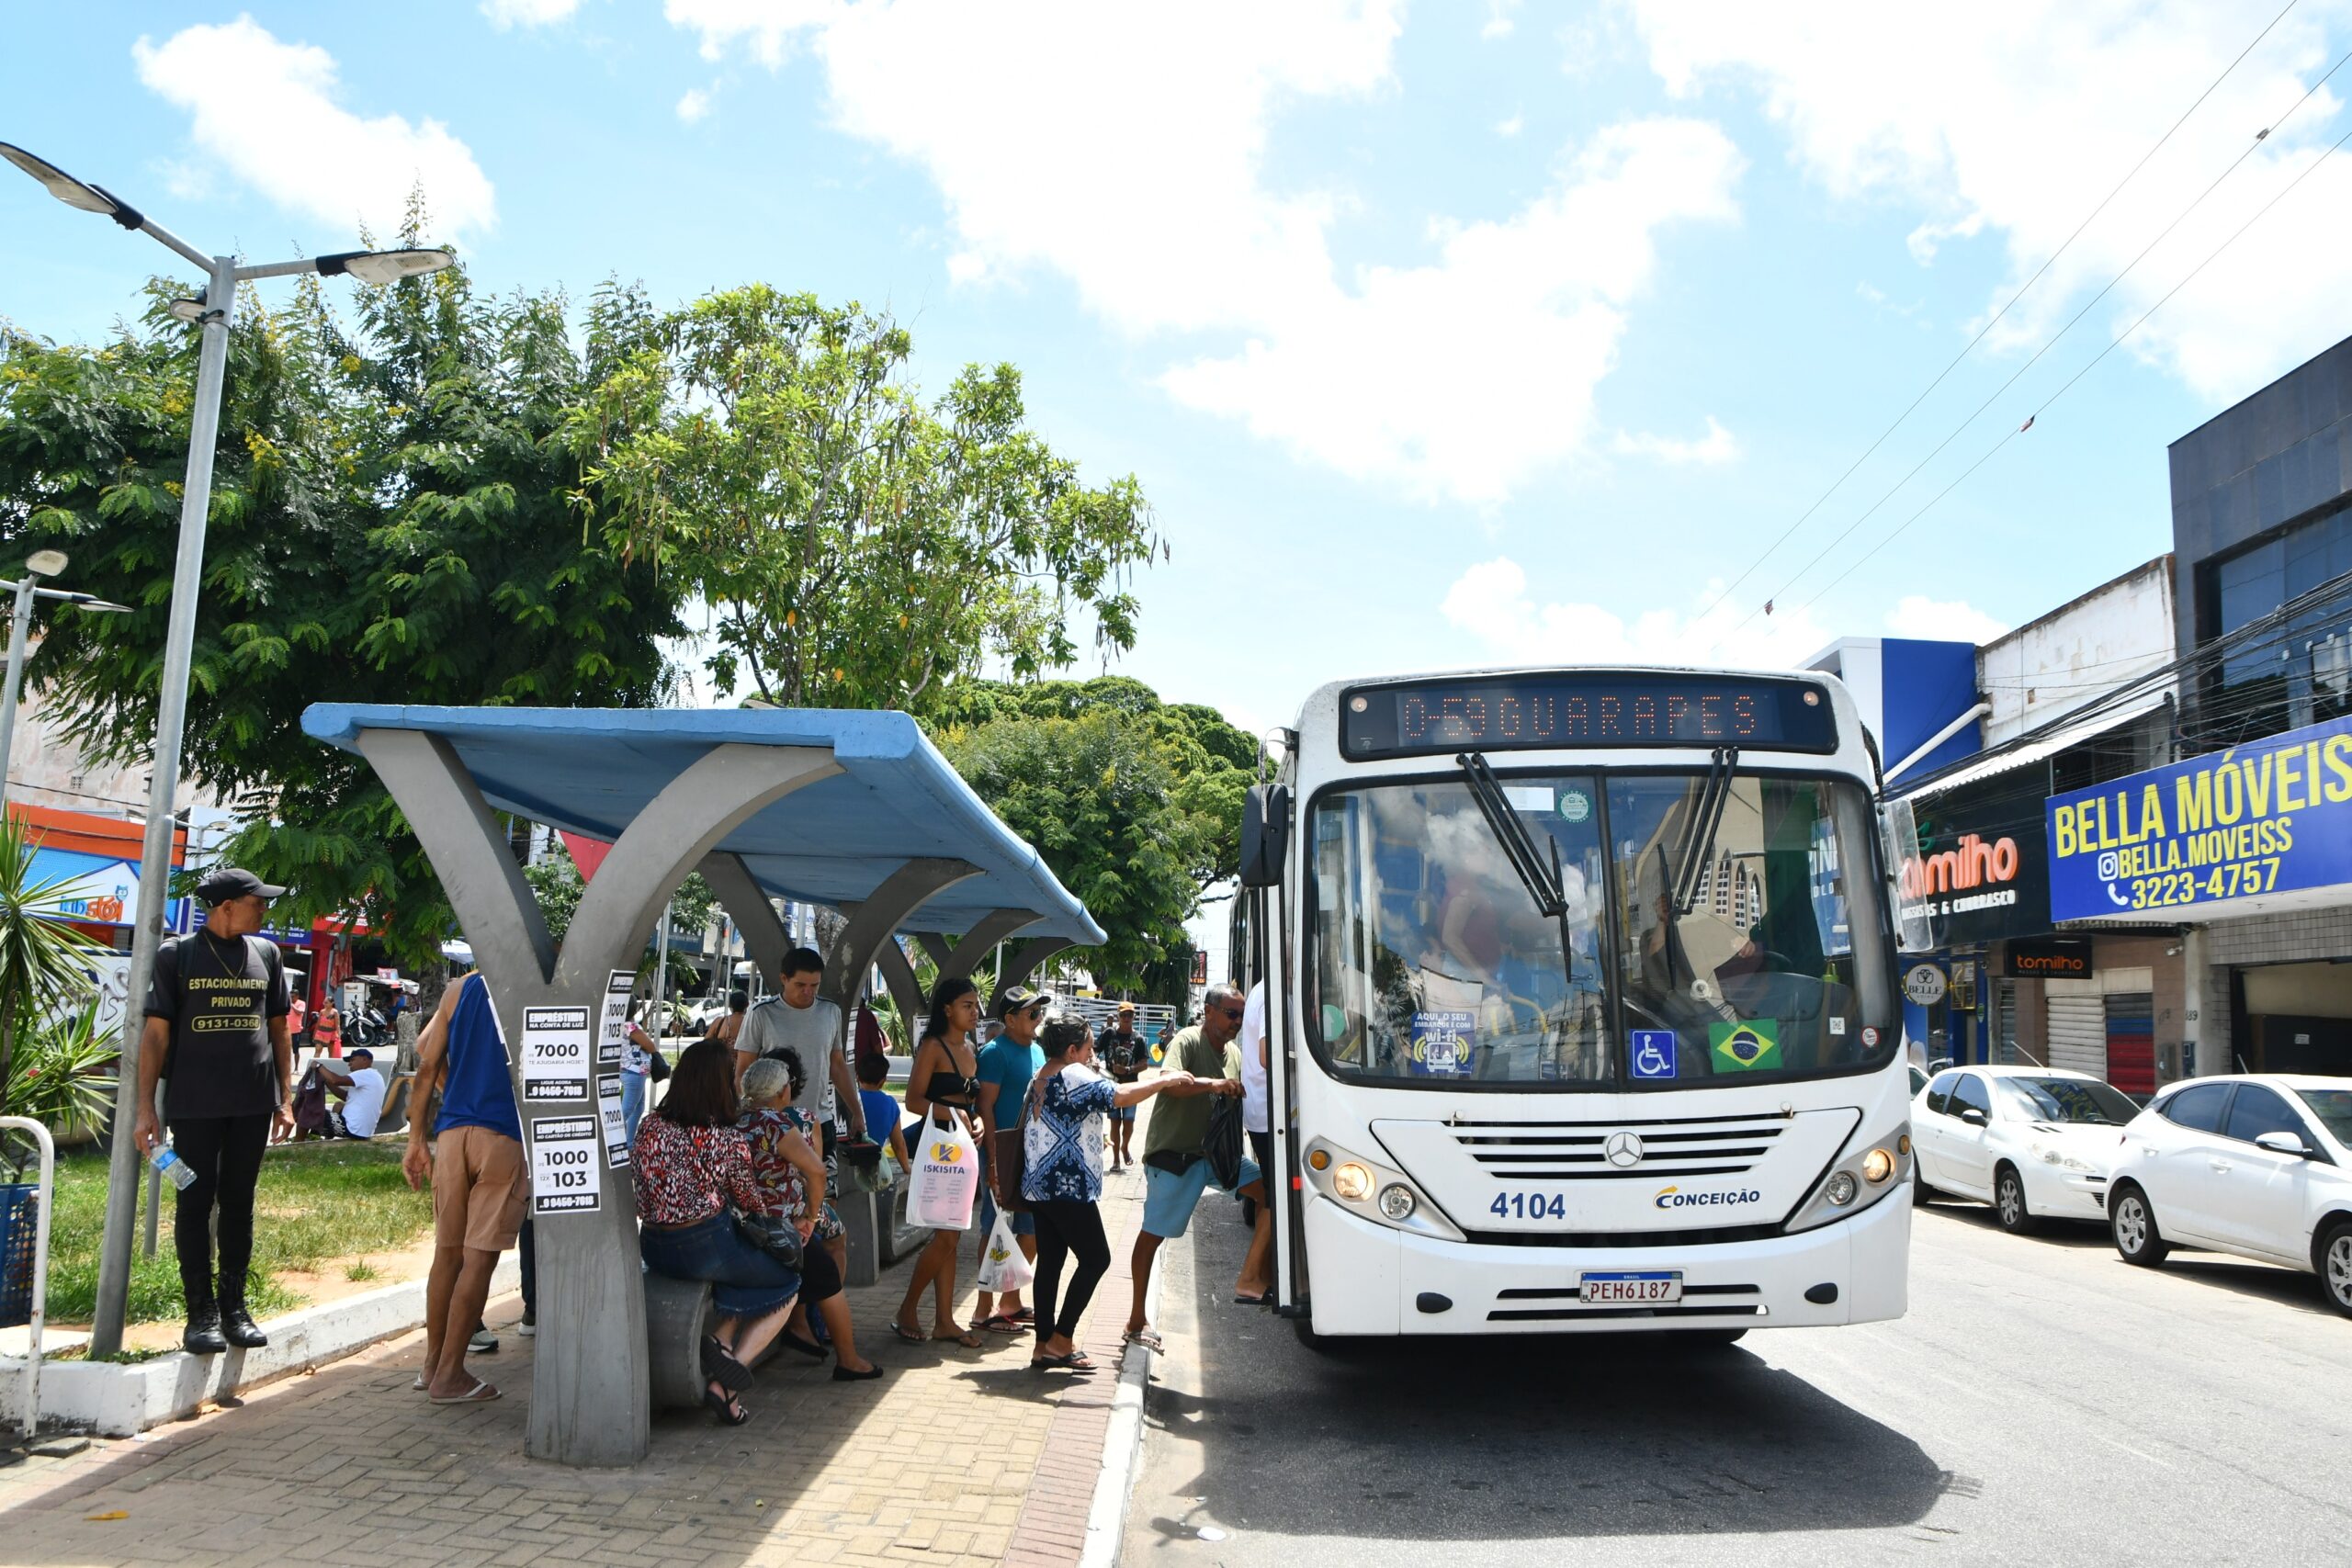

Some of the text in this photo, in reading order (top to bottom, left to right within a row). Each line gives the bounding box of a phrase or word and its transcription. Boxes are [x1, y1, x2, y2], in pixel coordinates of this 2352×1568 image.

[1499, 695, 1756, 737] GUARAPES
[2054, 733, 2352, 858] BELLA MÓVEIS
[2119, 817, 2292, 879] BELLA.MOVEISS
[2132, 856, 2280, 909] 3223-4757
[2017, 954, 2084, 970] tomilho
[1908, 985, 1942, 995] BELLE
[211, 997, 251, 1007] PRIVADO
[529, 1011, 585, 1023] EMPRÉSTIMO
[608, 1004, 625, 1016] 1000
[1417, 1013, 1441, 1022] AQUI,
[608, 1023, 621, 1038] 103
[535, 1044, 579, 1057] 7000
[605, 1109, 621, 1123] 7000
[536, 1121, 593, 1134] EMPRÉSTIMO
[544, 1150, 588, 1166] 1000
[924, 1164, 965, 1174] ISKISITA
[553, 1171, 587, 1187] 103
[1490, 1192, 1566, 1220] 4104
[1655, 1188, 1760, 1209] CONCEIÇÃO
[1590, 1281, 1671, 1299] PEH6I87
